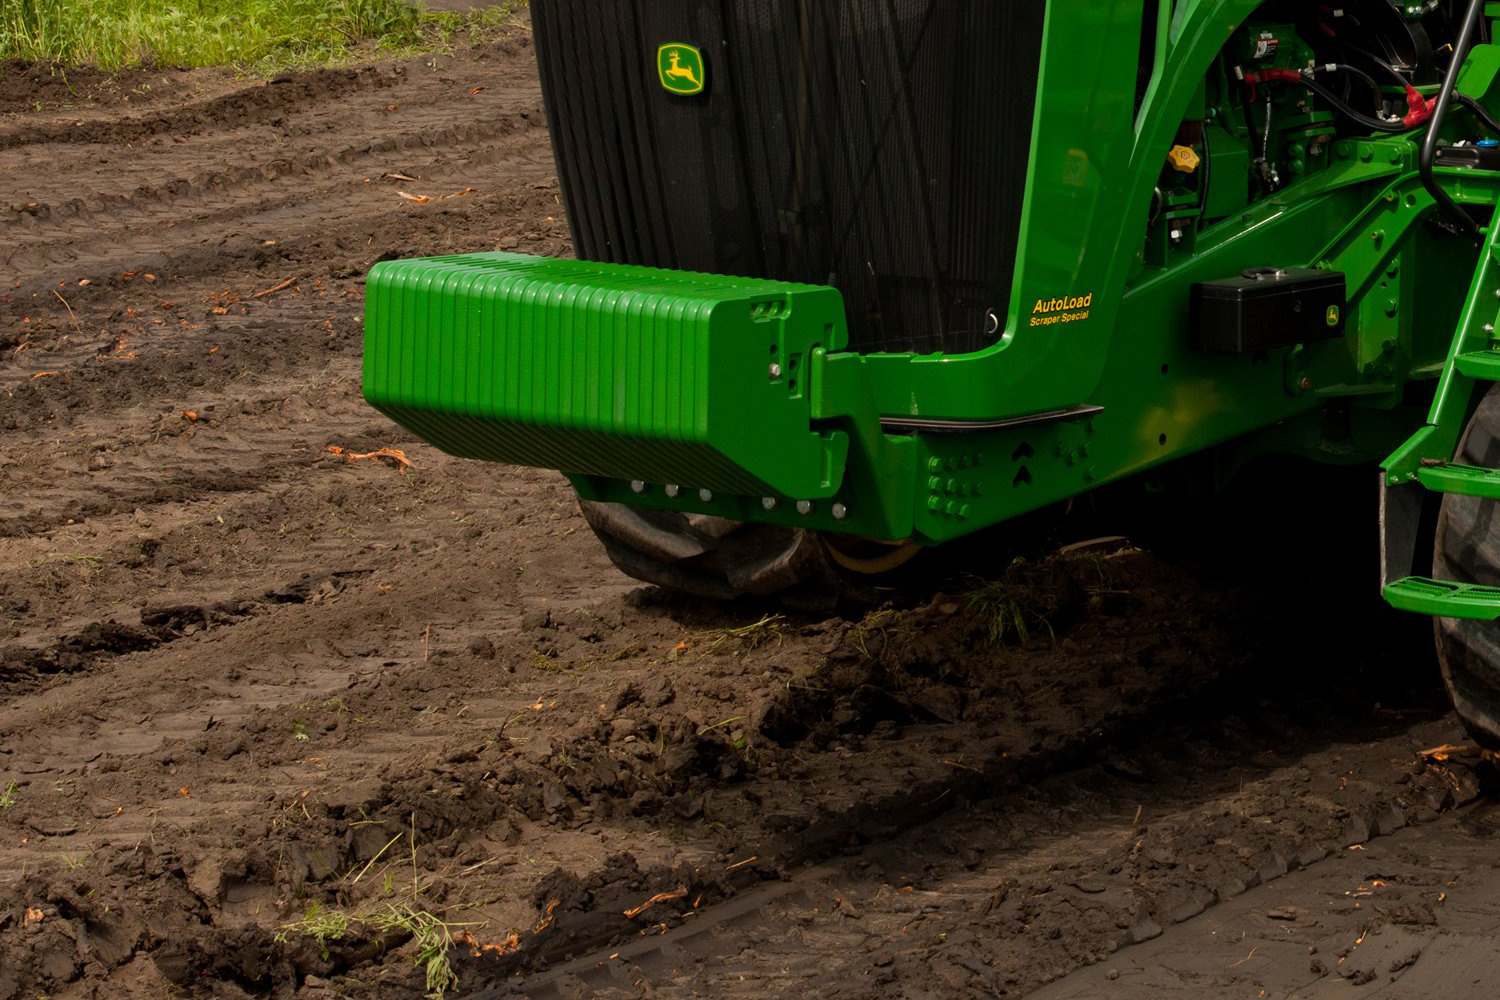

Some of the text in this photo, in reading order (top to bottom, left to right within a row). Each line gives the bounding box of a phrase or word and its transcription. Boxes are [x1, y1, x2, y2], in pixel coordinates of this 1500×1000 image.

[1032, 292, 1092, 314] AutoLoad
[1029, 310, 1089, 326] Scraper Special
